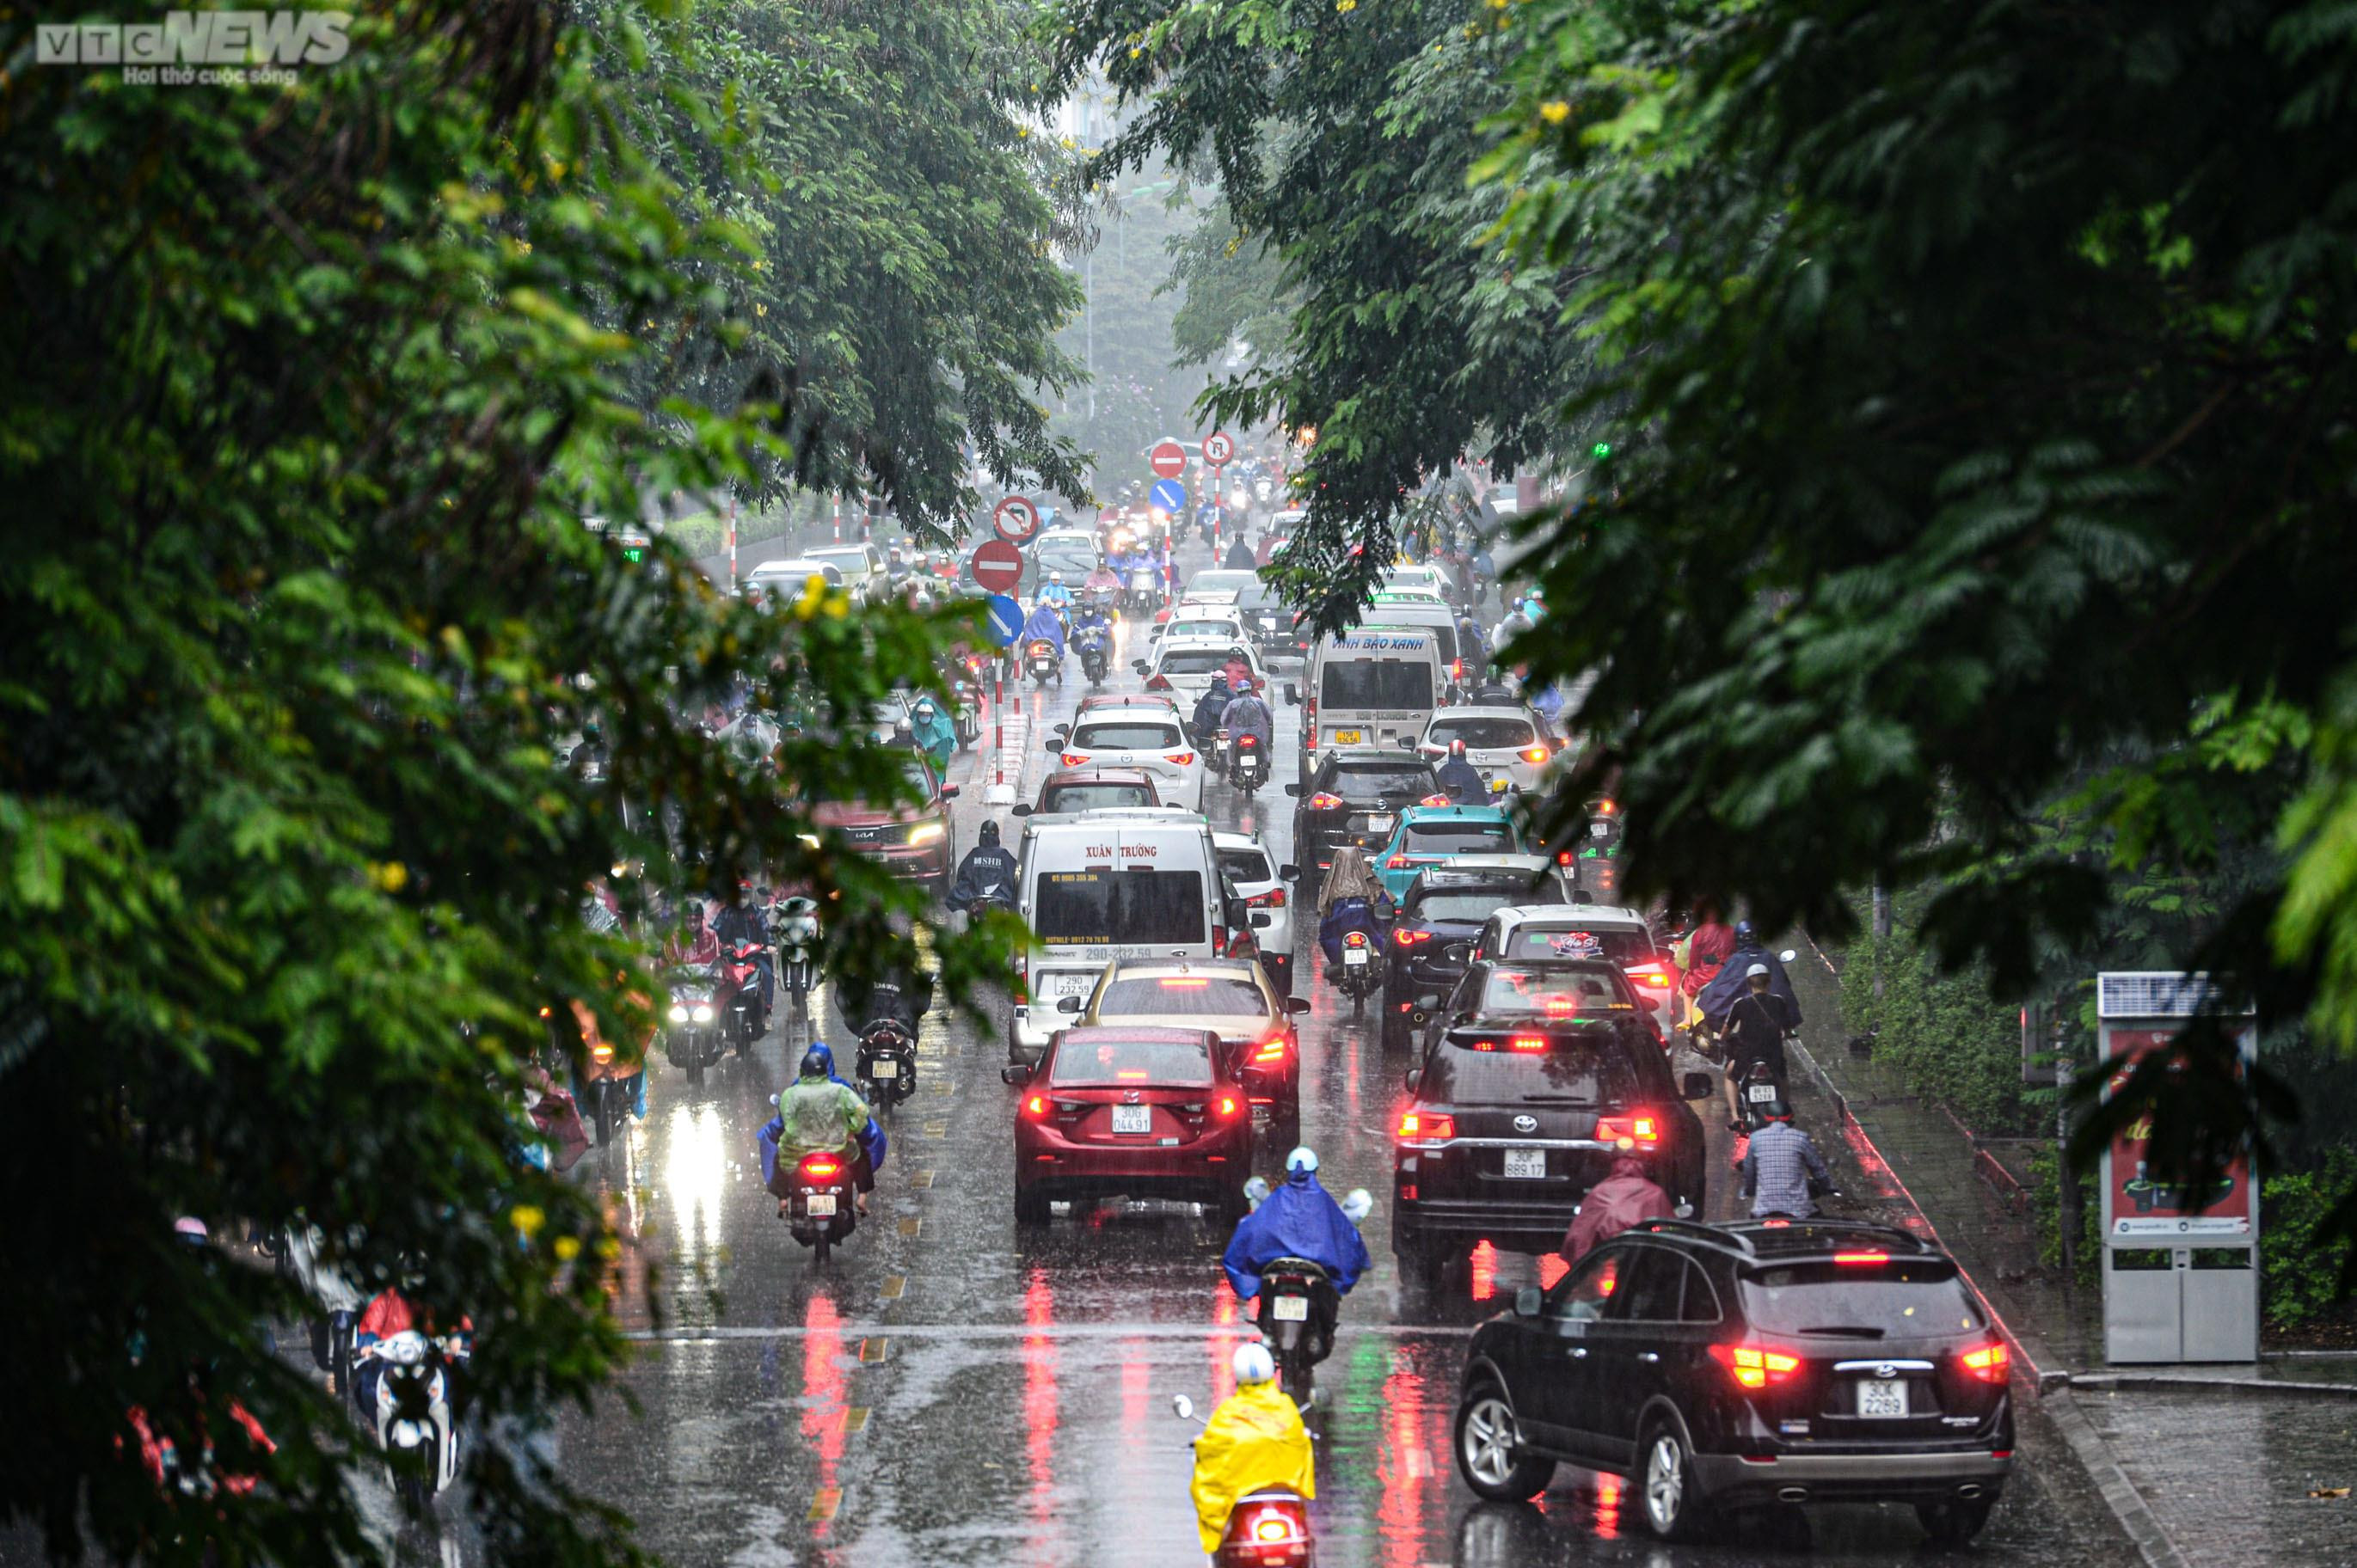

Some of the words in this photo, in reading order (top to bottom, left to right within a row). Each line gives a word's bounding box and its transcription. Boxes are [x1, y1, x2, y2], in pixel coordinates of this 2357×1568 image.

[1390, 639, 1424, 650] XANH
[1086, 844, 1112, 857] XUÂN
[1120, 842, 1157, 857] TRƯỜNG
[982, 857, 1002, 866] SHB
[1059, 985, 1089, 994] 232.59
[1121, 1106, 1141, 1118] 30G
[1114, 1119, 1148, 1131] 044.91
[1515, 1149, 1534, 1162] 30F
[1507, 1163, 1544, 1176] 889.17
